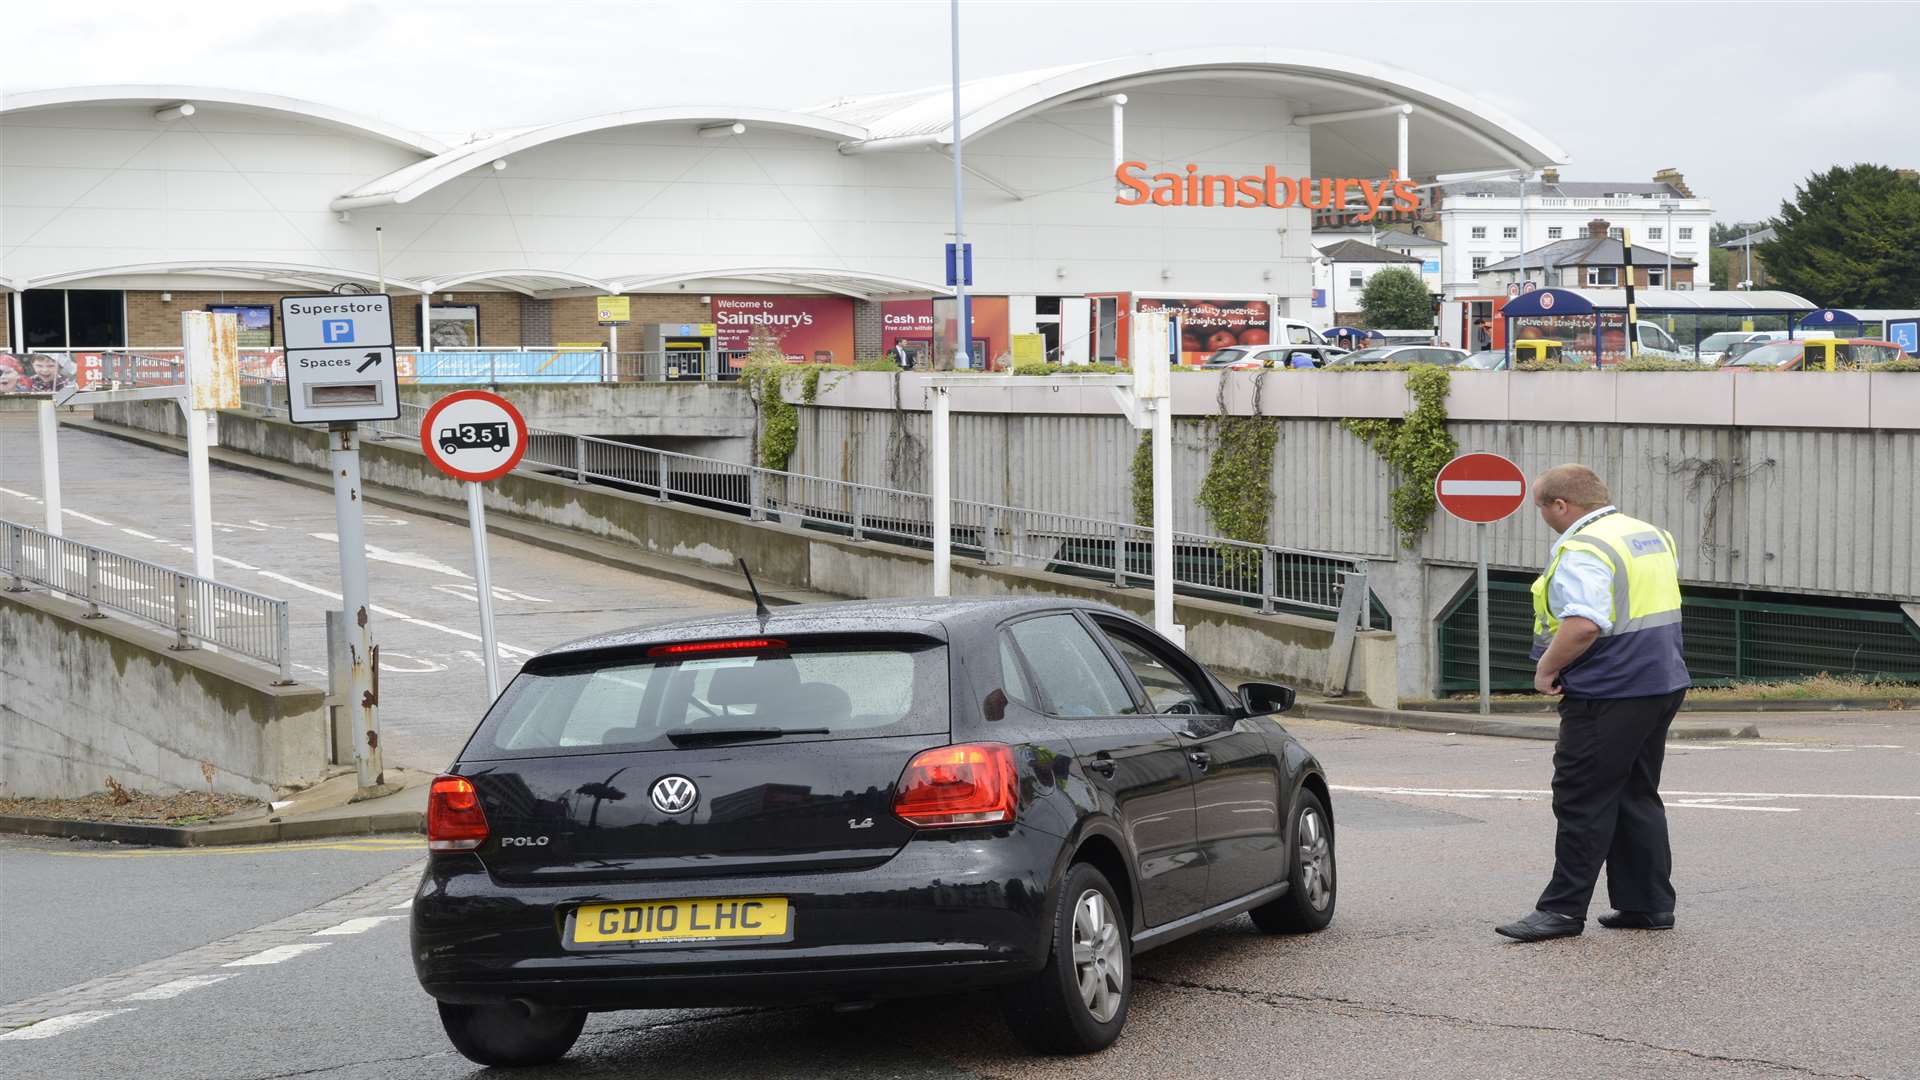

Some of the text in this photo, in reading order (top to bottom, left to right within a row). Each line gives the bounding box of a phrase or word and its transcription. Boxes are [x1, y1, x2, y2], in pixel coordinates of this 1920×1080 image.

[1115, 161, 1420, 222] Sainsbury's
[290, 303, 383, 315] Superstore
[718, 300, 774, 309] Welcome to
[1191, 304, 1221, 316] quality
[717, 311, 813, 328] Sainsbury's
[884, 314, 914, 324] Cash
[1185, 316, 1267, 328] straight to your door
[1608, 319, 1623, 327] door
[330, 321, 350, 342] P
[300, 358, 351, 369] Spaces
[501, 836, 549, 848] POLO
[598, 902, 764, 935] GD10 LHC
